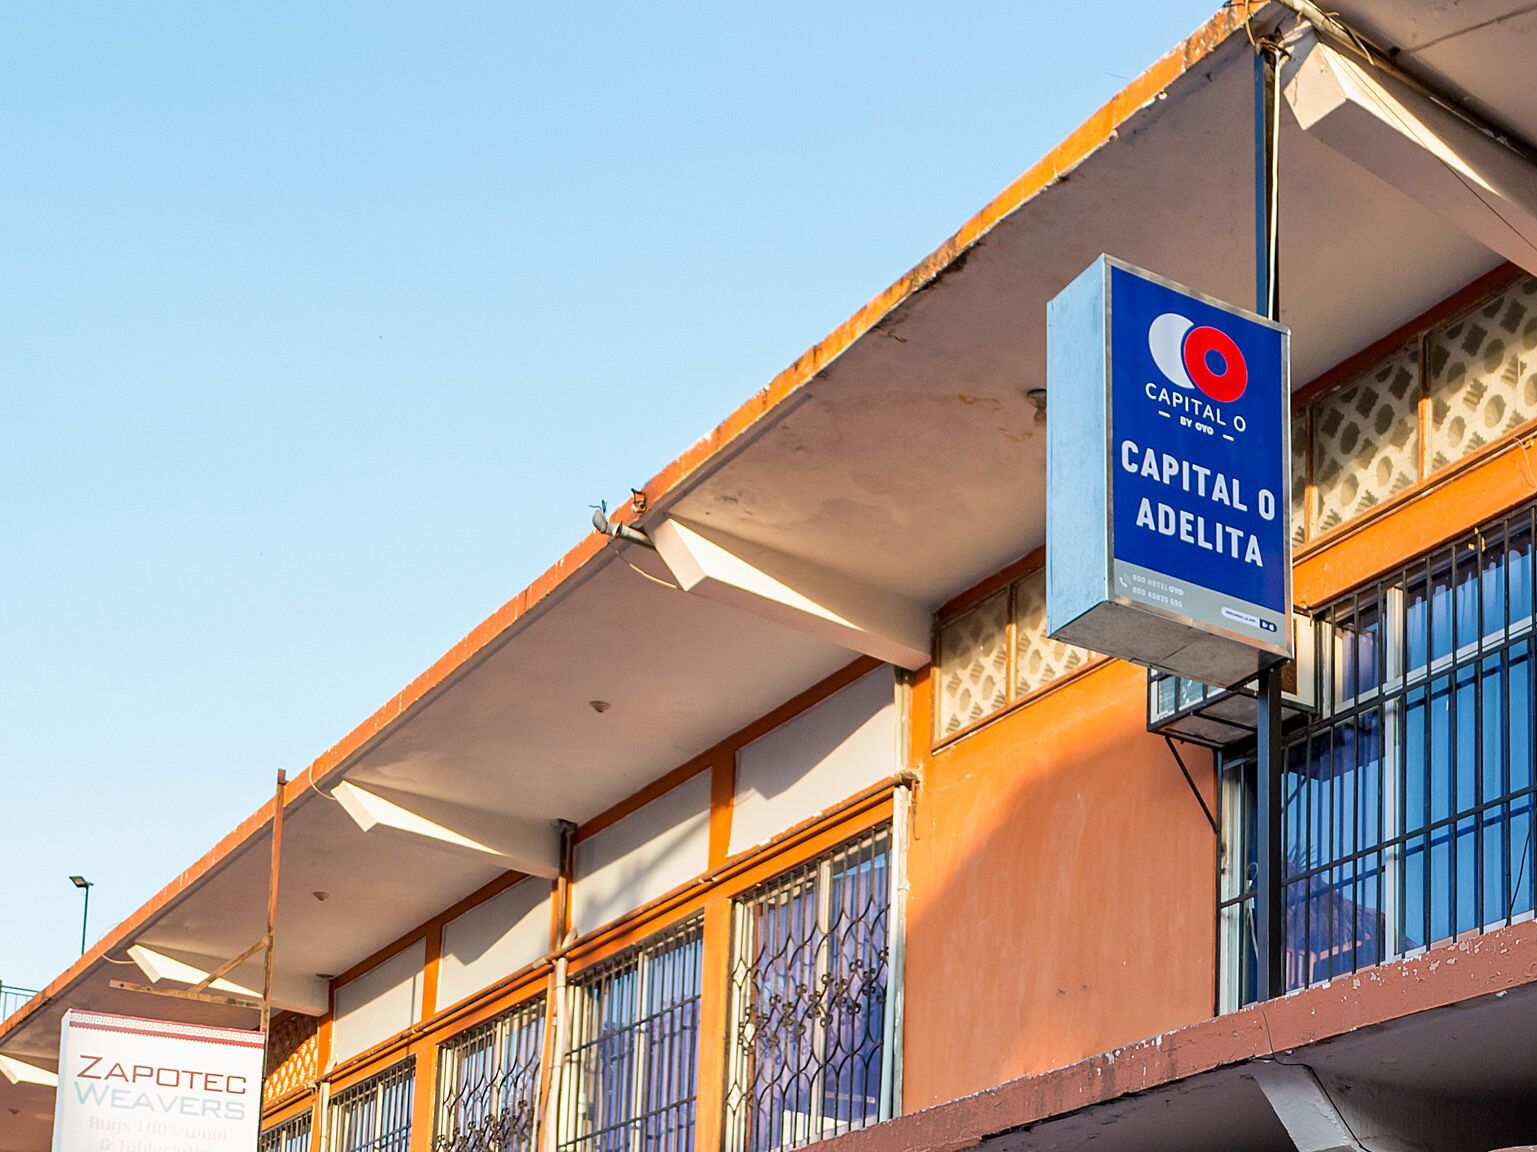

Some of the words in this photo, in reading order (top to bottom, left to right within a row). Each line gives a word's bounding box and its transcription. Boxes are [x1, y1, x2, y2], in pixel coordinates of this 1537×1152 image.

[1145, 383, 1226, 426] CAPITAL
[1233, 415, 1246, 432] O
[1179, 416, 1192, 427] BY
[1195, 422, 1214, 435] OYO
[1120, 439, 1248, 512] CAPITAL
[1258, 488, 1276, 521] O
[1136, 497, 1264, 568] ADELITA
[76, 1055, 247, 1095] ZAPOTEC
[74, 1080, 246, 1121] WEAVERS
[88, 1115, 131, 1135] Rugs
[185, 1127, 227, 1142] wool
